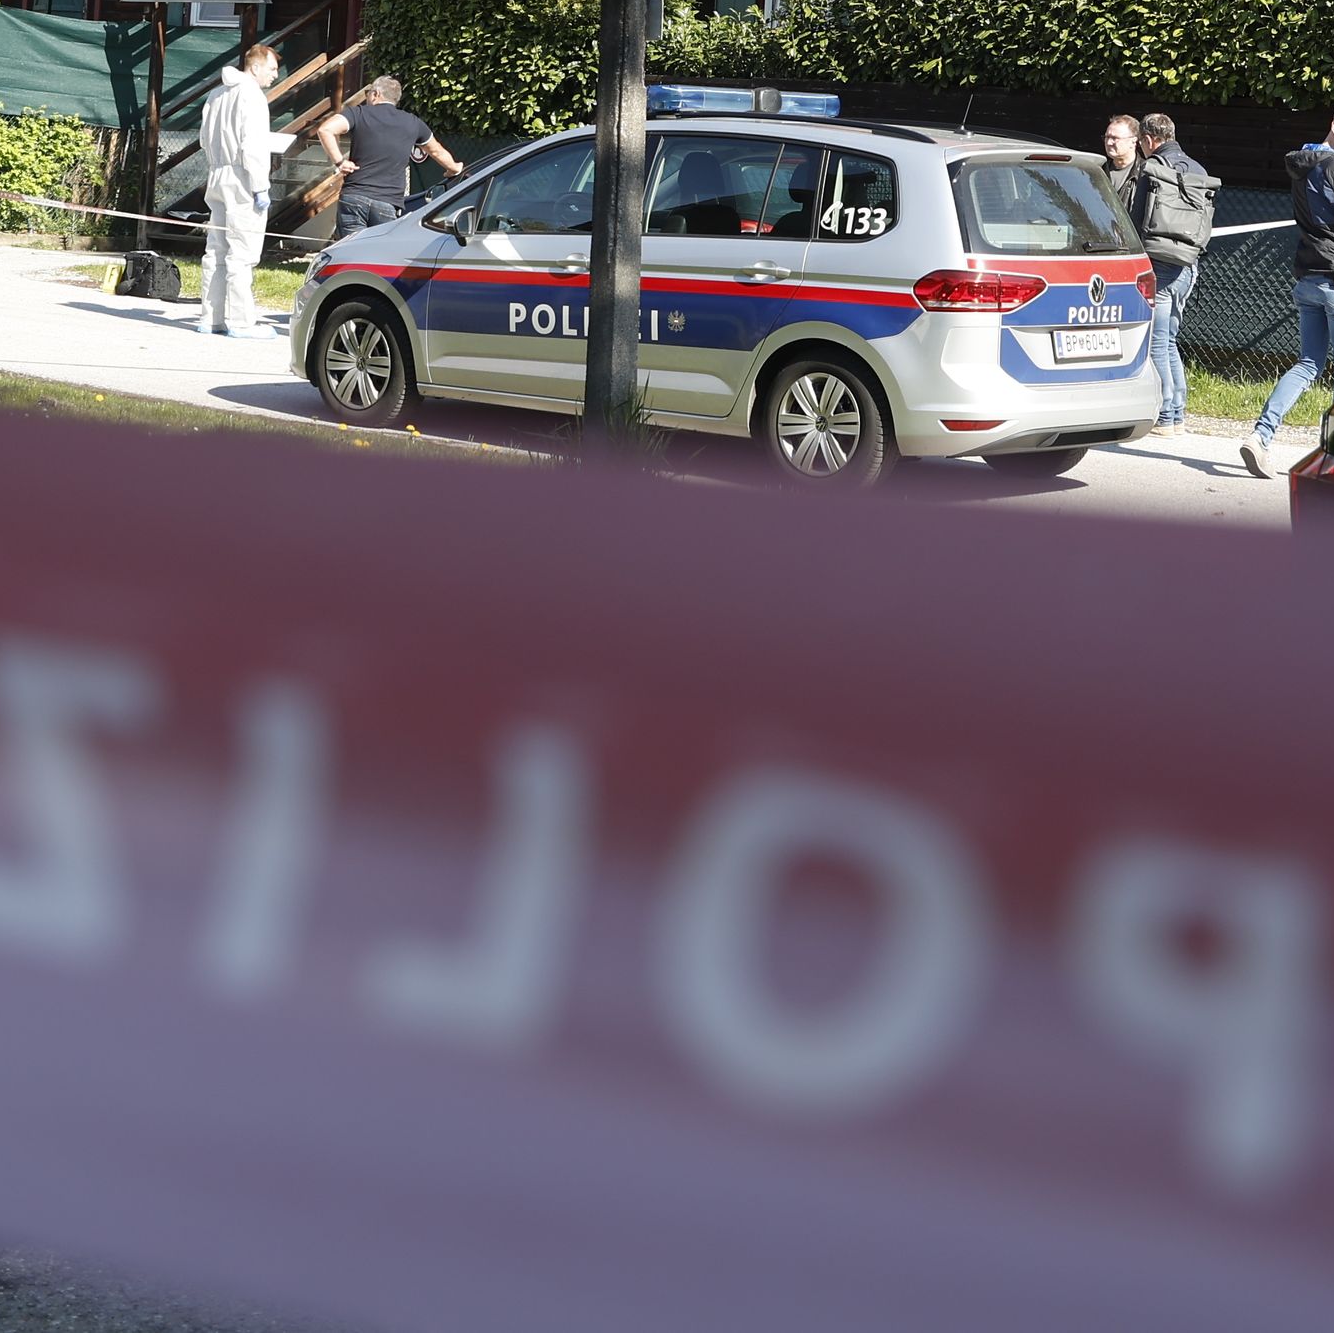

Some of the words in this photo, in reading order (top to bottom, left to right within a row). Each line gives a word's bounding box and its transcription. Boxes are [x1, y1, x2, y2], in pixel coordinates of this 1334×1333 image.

[844, 207, 887, 236] 133
[509, 302, 659, 341] POLII
[1068, 305, 1122, 324] POLIZEI
[1066, 335, 1077, 352] BP
[1086, 333, 1116, 351] 60434
